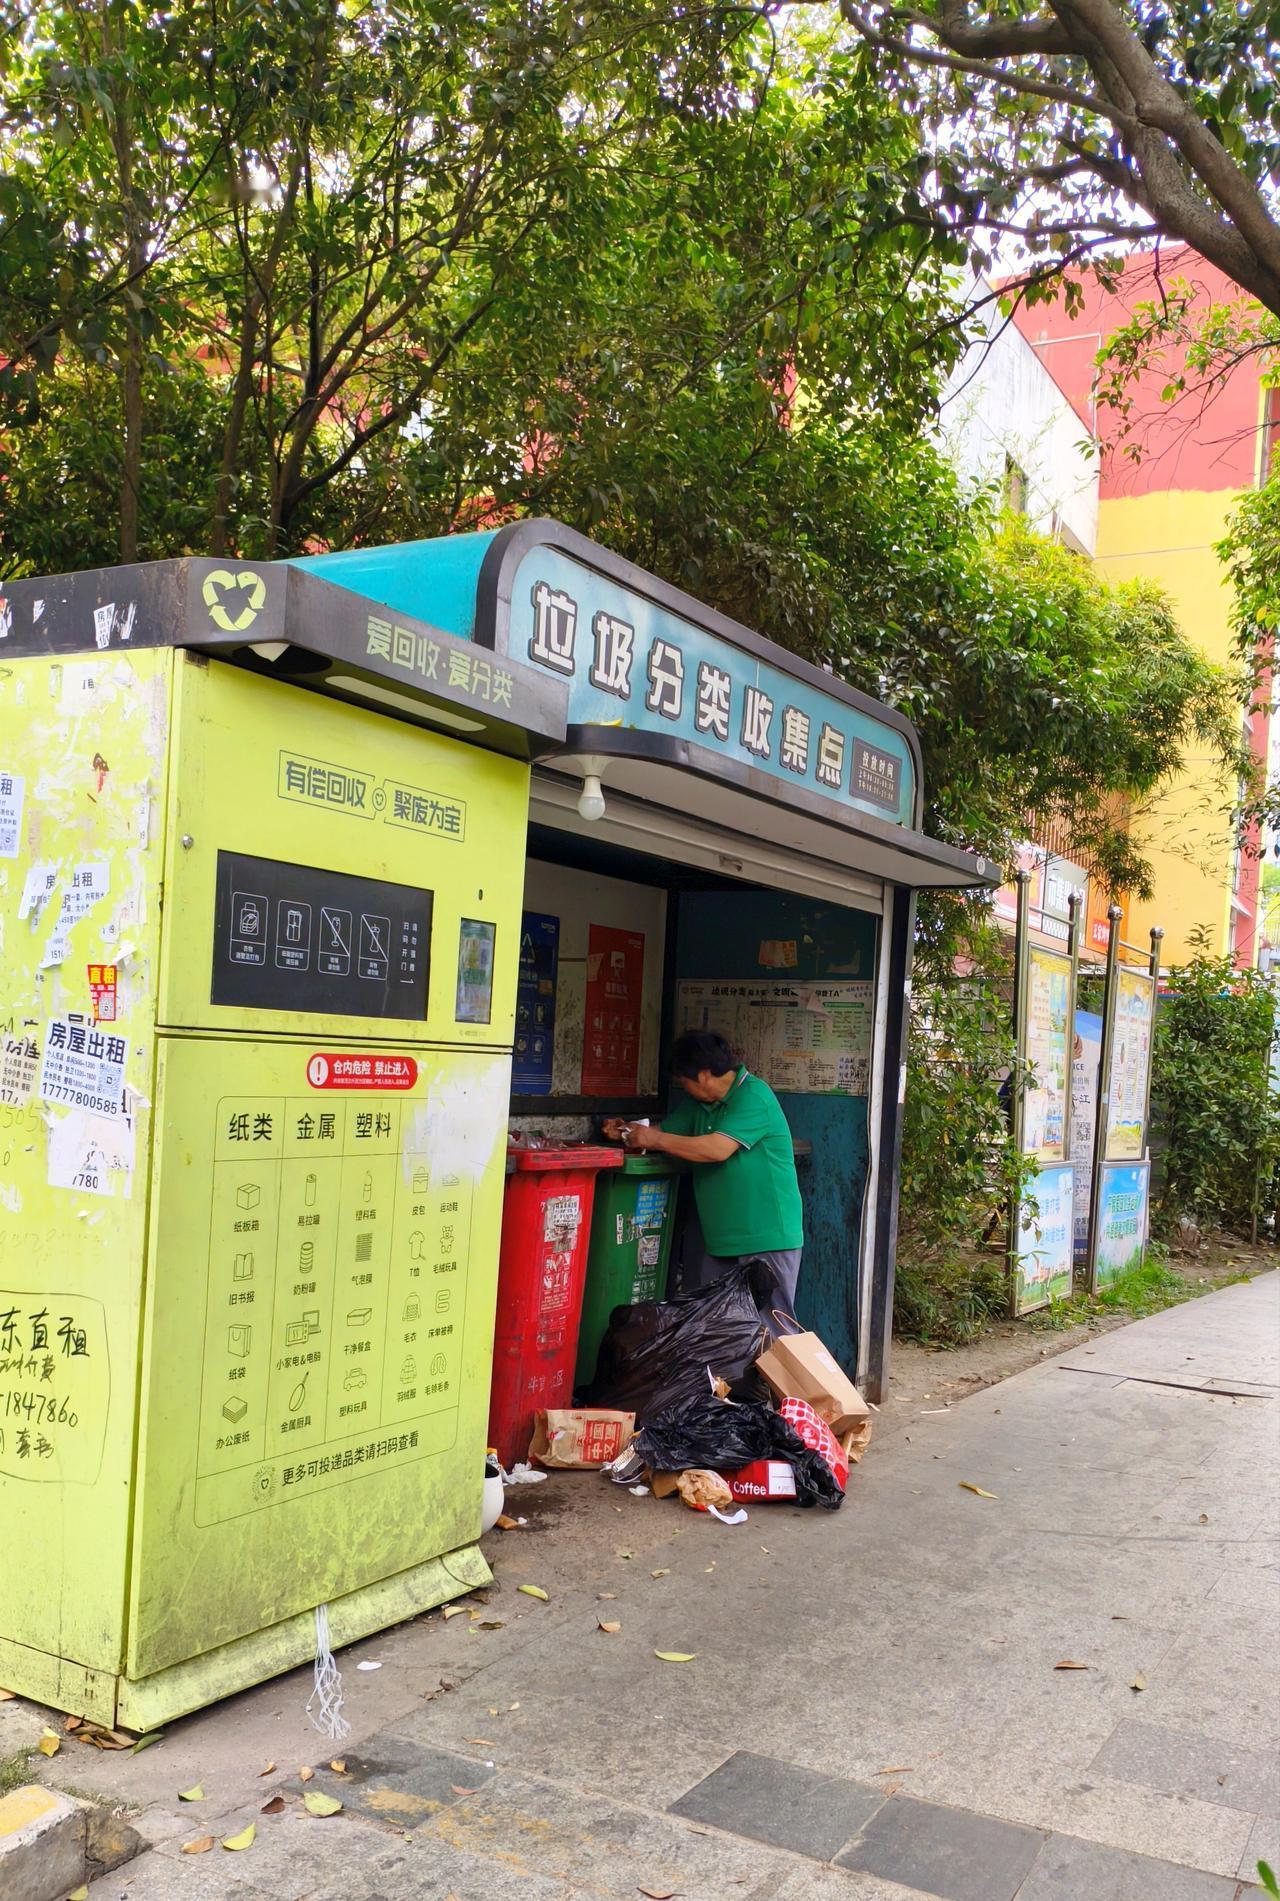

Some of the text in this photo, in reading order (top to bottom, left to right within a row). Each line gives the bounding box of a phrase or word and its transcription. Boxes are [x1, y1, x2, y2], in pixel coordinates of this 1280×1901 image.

[529, 580, 846, 790] 垃圾分类收集点
[862, 750, 894, 779] 投放时间
[286, 761, 461, 834] 有偿回收 聚废为宝
[48, 1022, 125, 1065] 房屋出租
[333, 1060, 410, 1076] 仓内危险 禁止进入
[42, 1082, 118, 1115] 17777800585
[228, 1112, 392, 1142] 纸类 金属 塑料
[233, 1220, 260, 1233] 纸板箱
[229, 1290, 256, 1306] 旧书报
[404, 1331, 417, 1343] 毛衣
[344, 1340, 372, 1356] 干净餐盒
[276, 1351, 321, 1371] 小家电&电脑
[228, 1366, 247, 1381] 纸袋
[0, 1391, 79, 1428] 1847860
[338, 1400, 367, 1418] 塑料玩具
[280, 1415, 312, 1434] 金属厨具
[215, 1430, 251, 1450] 办公废纸
[282, 1430, 419, 1487] 更多可投递品类请扫码查看
[733, 1482, 767, 1495] Coffee
